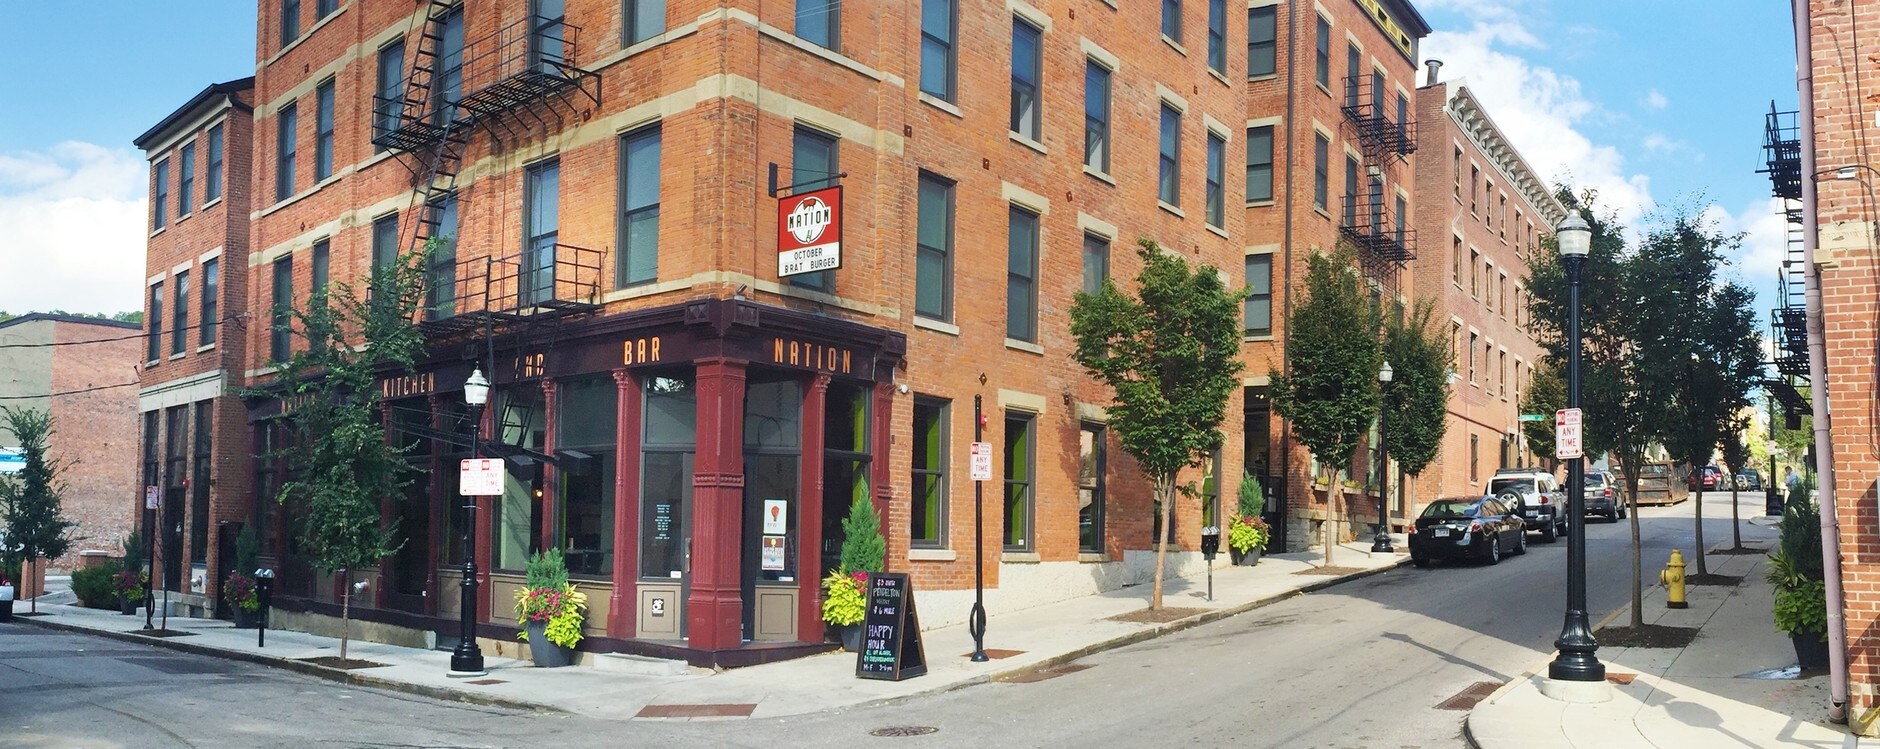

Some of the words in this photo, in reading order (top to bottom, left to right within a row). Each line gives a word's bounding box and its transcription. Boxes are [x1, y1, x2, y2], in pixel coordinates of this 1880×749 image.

[789, 209, 829, 229] NATION
[794, 247, 823, 260] OCTOBER
[784, 263, 803, 273] BRAT
[810, 257, 836, 269] BURGER
[774, 338, 851, 374] NATION
[383, 372, 435, 398] KITCHEN
[624, 336, 660, 366] BAR
[1562, 427, 1575, 436] ANY
[1561, 438, 1577, 447] TIME
[976, 464, 988, 472] TIME
[868, 625, 893, 639] HAPPY
[867, 640, 885, 650] HOUR
